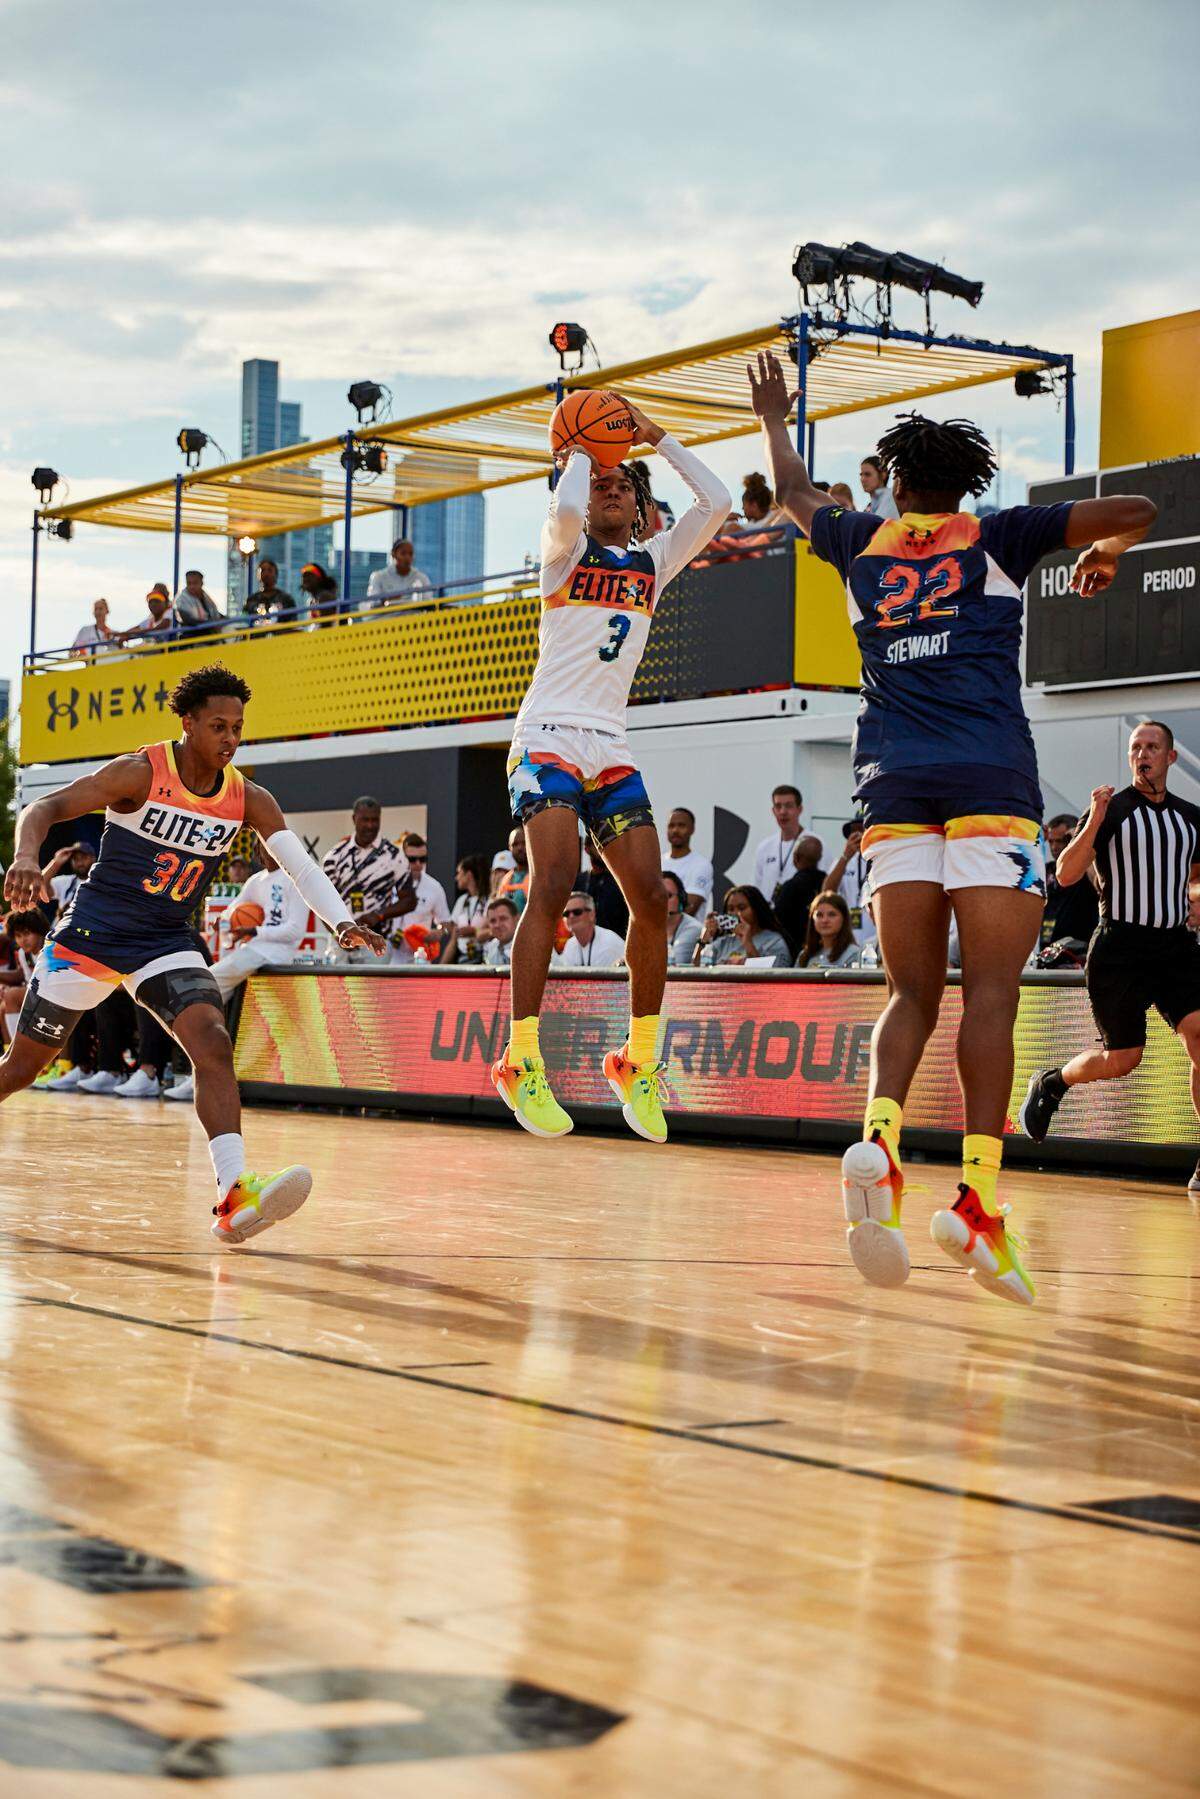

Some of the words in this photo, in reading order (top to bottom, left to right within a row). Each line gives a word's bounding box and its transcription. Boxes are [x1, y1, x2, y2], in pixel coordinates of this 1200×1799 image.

[569, 571, 627, 604] ELITE
[874, 556, 963, 631] 22
[1143, 566, 1195, 593] PERIOD
[599, 613, 631, 663] 3
[884, 630, 950, 664] STEWART
[140, 807, 204, 848] ELITE
[142, 851, 205, 902] 30
